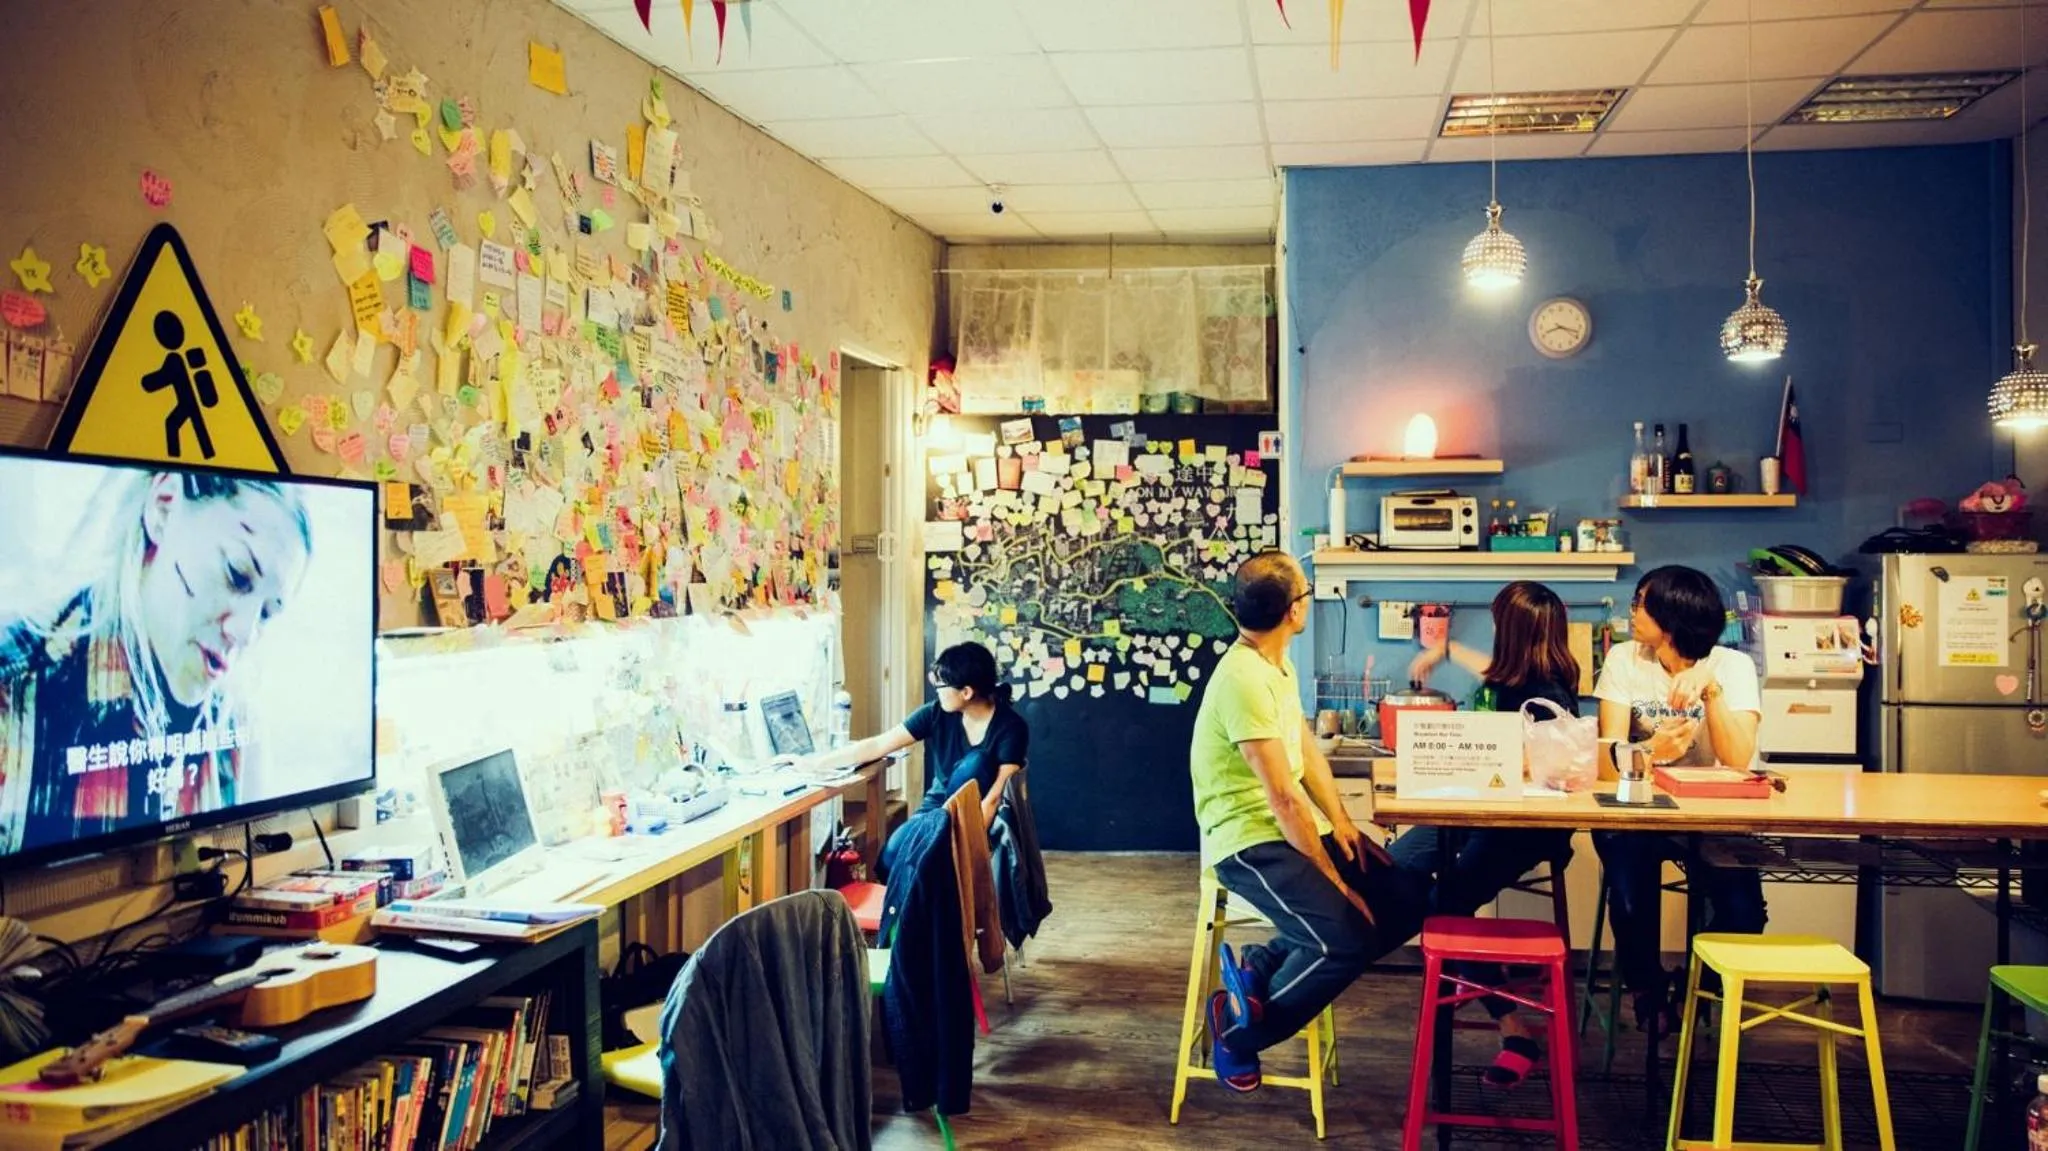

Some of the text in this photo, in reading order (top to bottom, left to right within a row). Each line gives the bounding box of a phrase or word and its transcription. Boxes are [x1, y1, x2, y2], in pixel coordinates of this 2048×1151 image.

[1176, 465, 1212, 483] 途中
[1137, 487, 1212, 498] ON MY WAY
[1412, 742, 1426, 750] AM
[1458, 742, 1472, 751] AM
